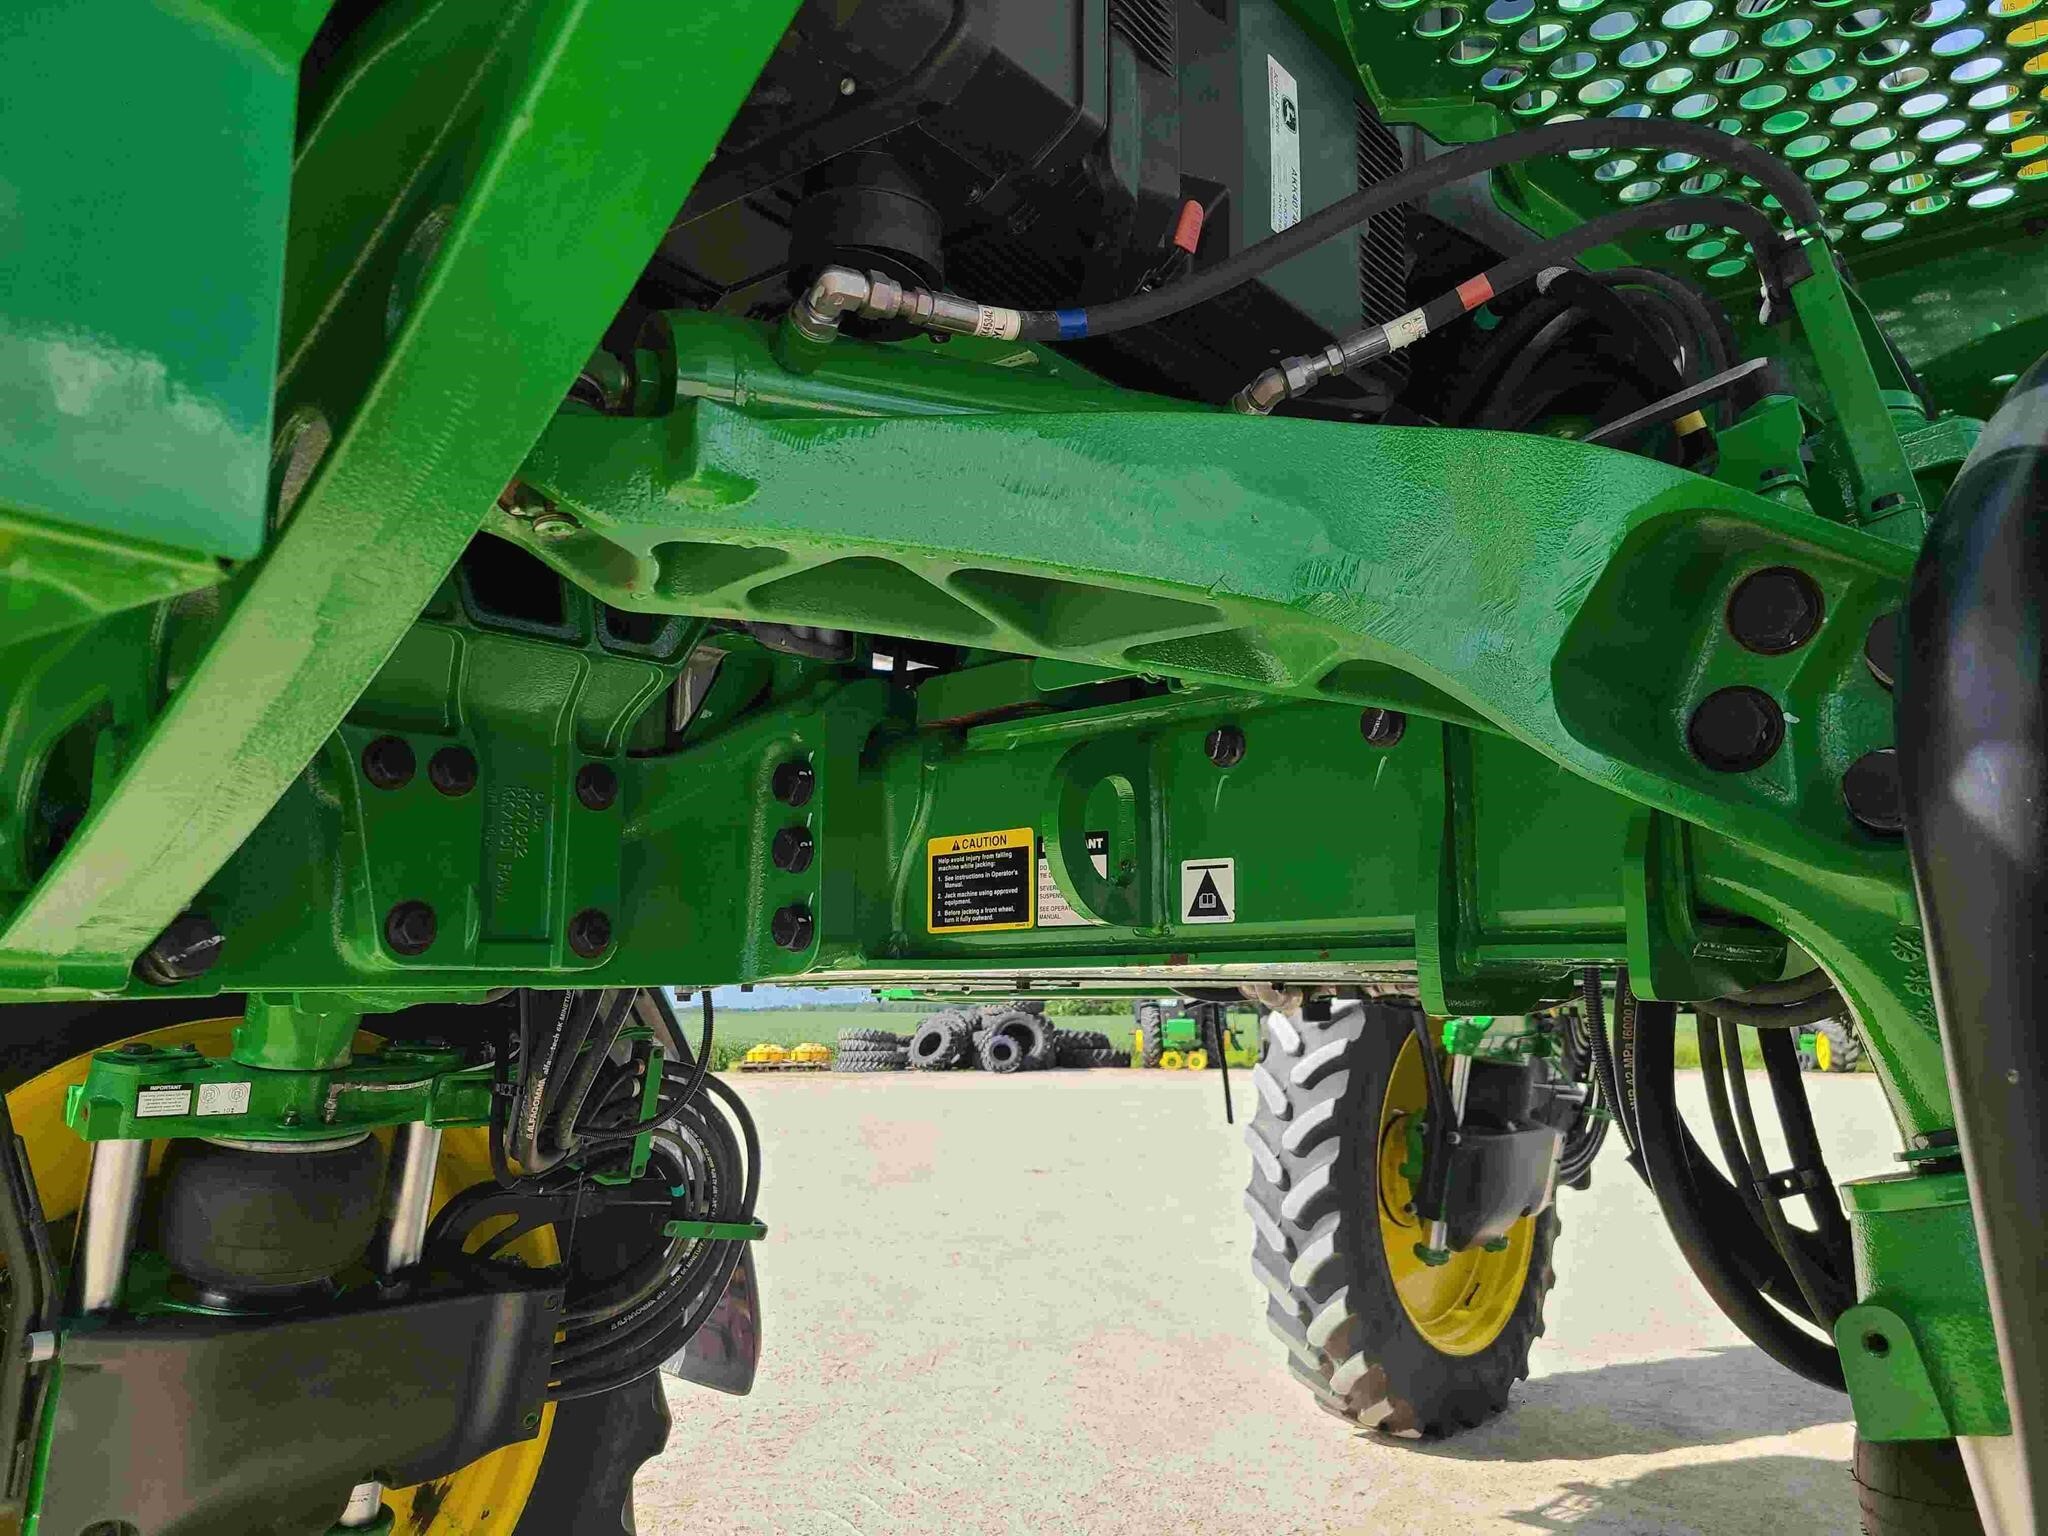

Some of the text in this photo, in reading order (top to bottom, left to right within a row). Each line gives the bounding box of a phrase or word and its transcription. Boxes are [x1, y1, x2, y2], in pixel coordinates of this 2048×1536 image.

[962, 834, 1007, 850] CAUTION
[938, 857, 950, 865] Help
[966, 854, 981, 862] injury
[995, 851, 1013, 859] falling
[975, 860, 996, 869] jacking:
[955, 872, 984, 881] instructions
[991, 869, 1019, 878] Operator's
[957, 890, 978, 898] machine
[979, 889, 993, 897] using
[994, 887, 1019, 896] approved
[961, 907, 980, 917] jacking
[960, 915, 971, 923] fully
[1622, 1043, 1634, 1068] MPa
